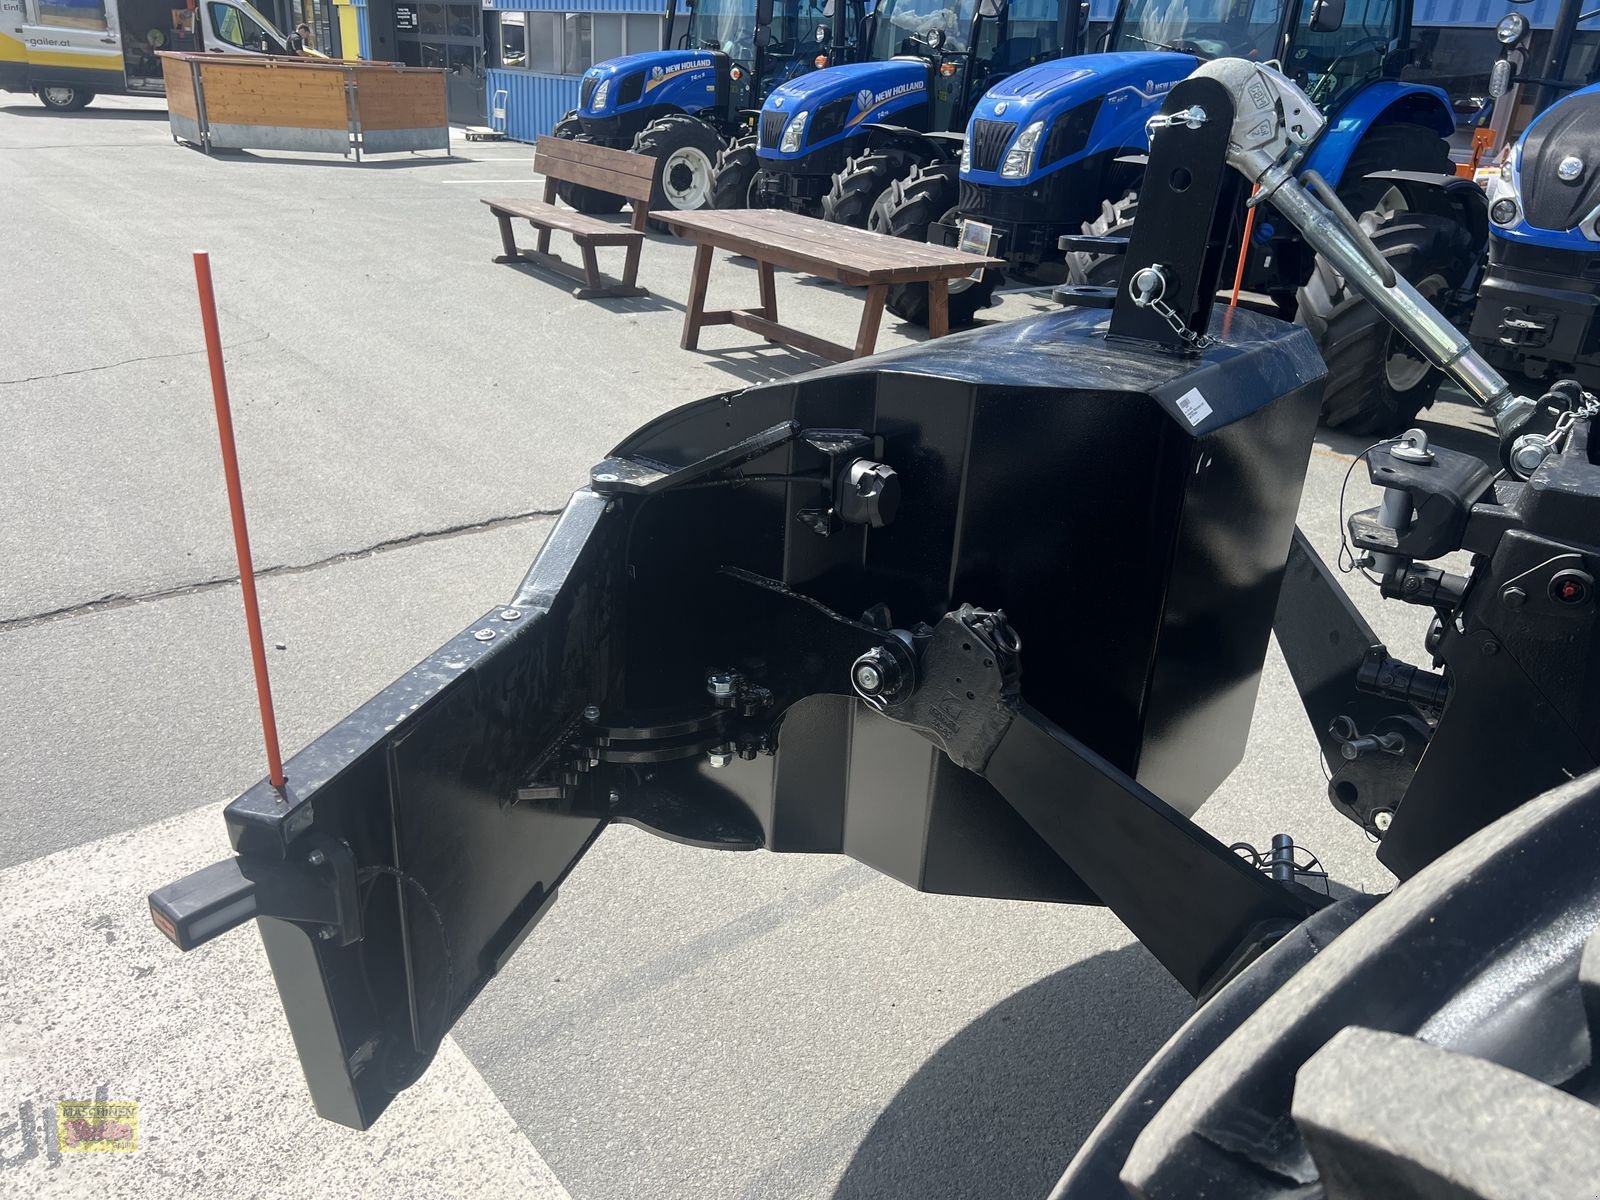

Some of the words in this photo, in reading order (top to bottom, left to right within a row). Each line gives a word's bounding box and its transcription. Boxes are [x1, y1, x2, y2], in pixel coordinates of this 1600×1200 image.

[665, 62, 681, 74] NEW
[681, 59, 711, 70] HOLLAND
[875, 88, 893, 103] NEW
[892, 80, 924, 96] HOLLAND
